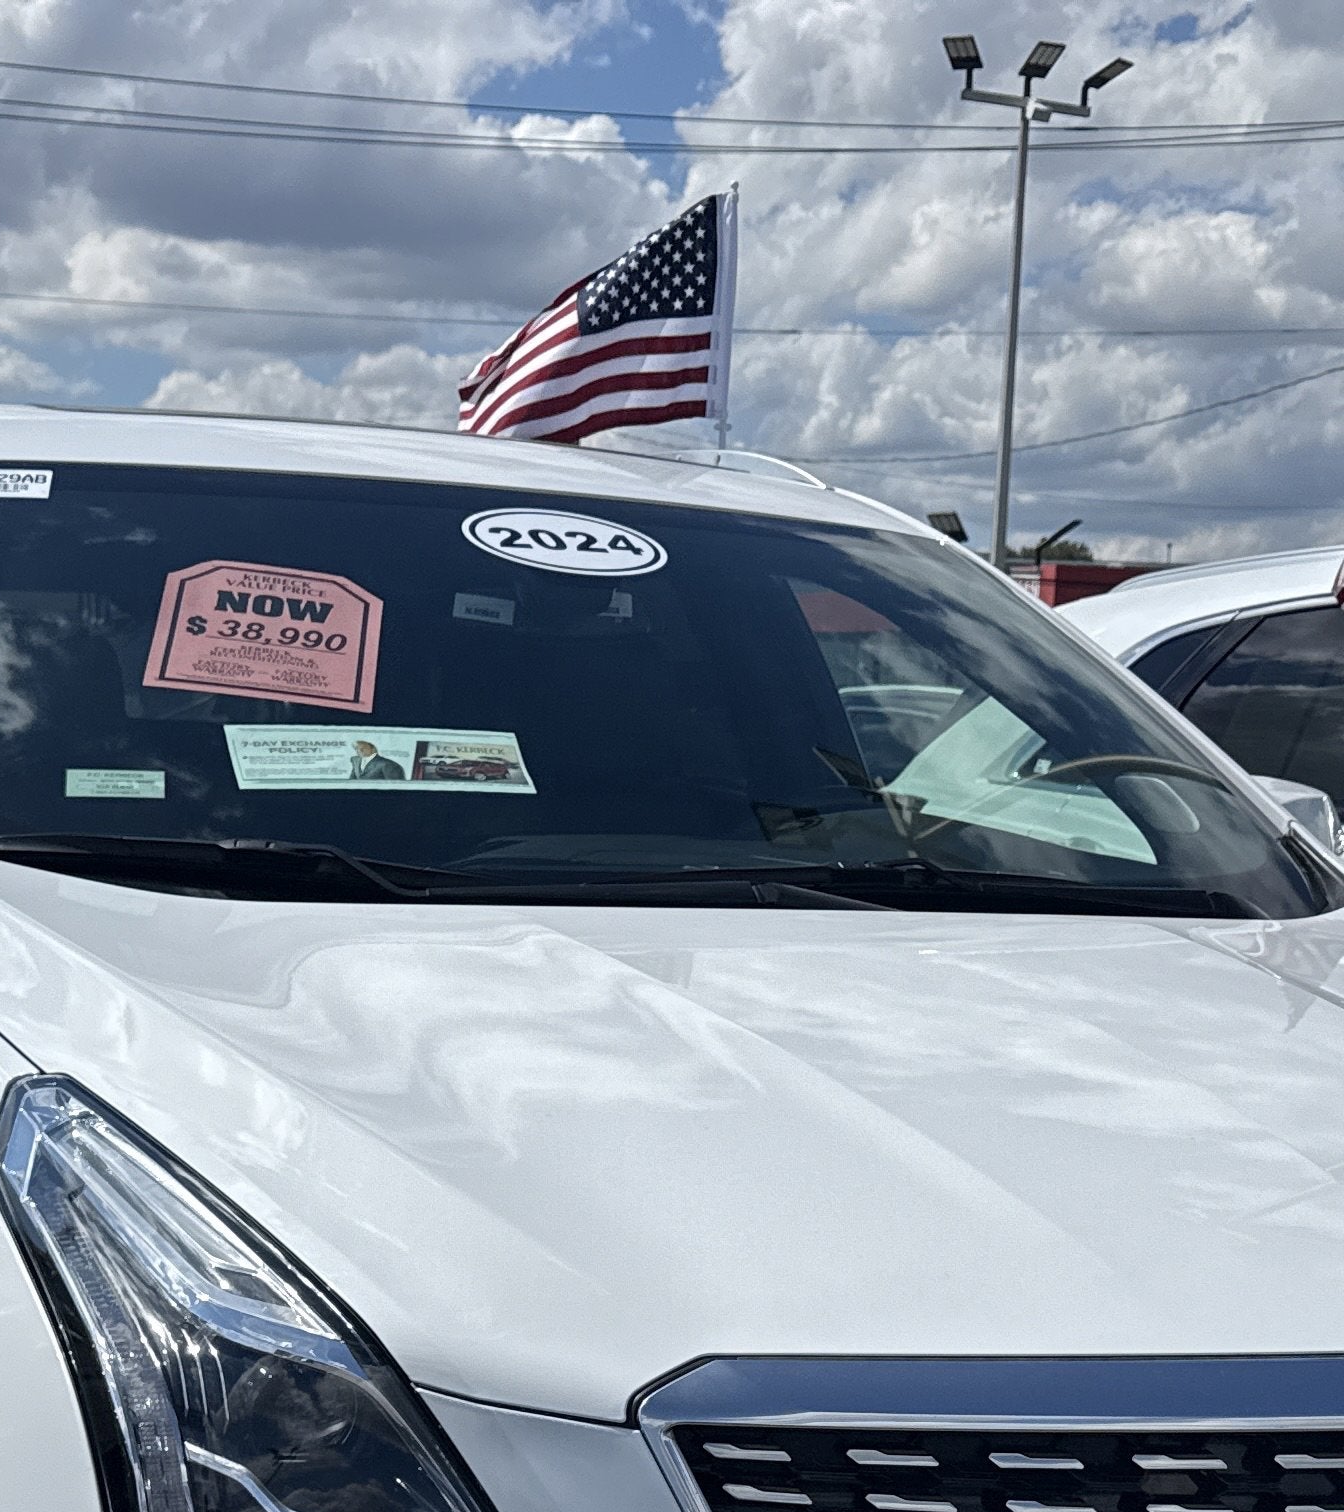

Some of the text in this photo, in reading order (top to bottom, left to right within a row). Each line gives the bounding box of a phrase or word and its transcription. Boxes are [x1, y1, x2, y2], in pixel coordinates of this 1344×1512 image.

[488, 526, 645, 556] 2024
[226, 578, 327, 597] VALUE PRICE
[244, 574, 311, 589] KERBECK
[214, 590, 334, 624] NOW
[186, 615, 348, 652] $ 38,990
